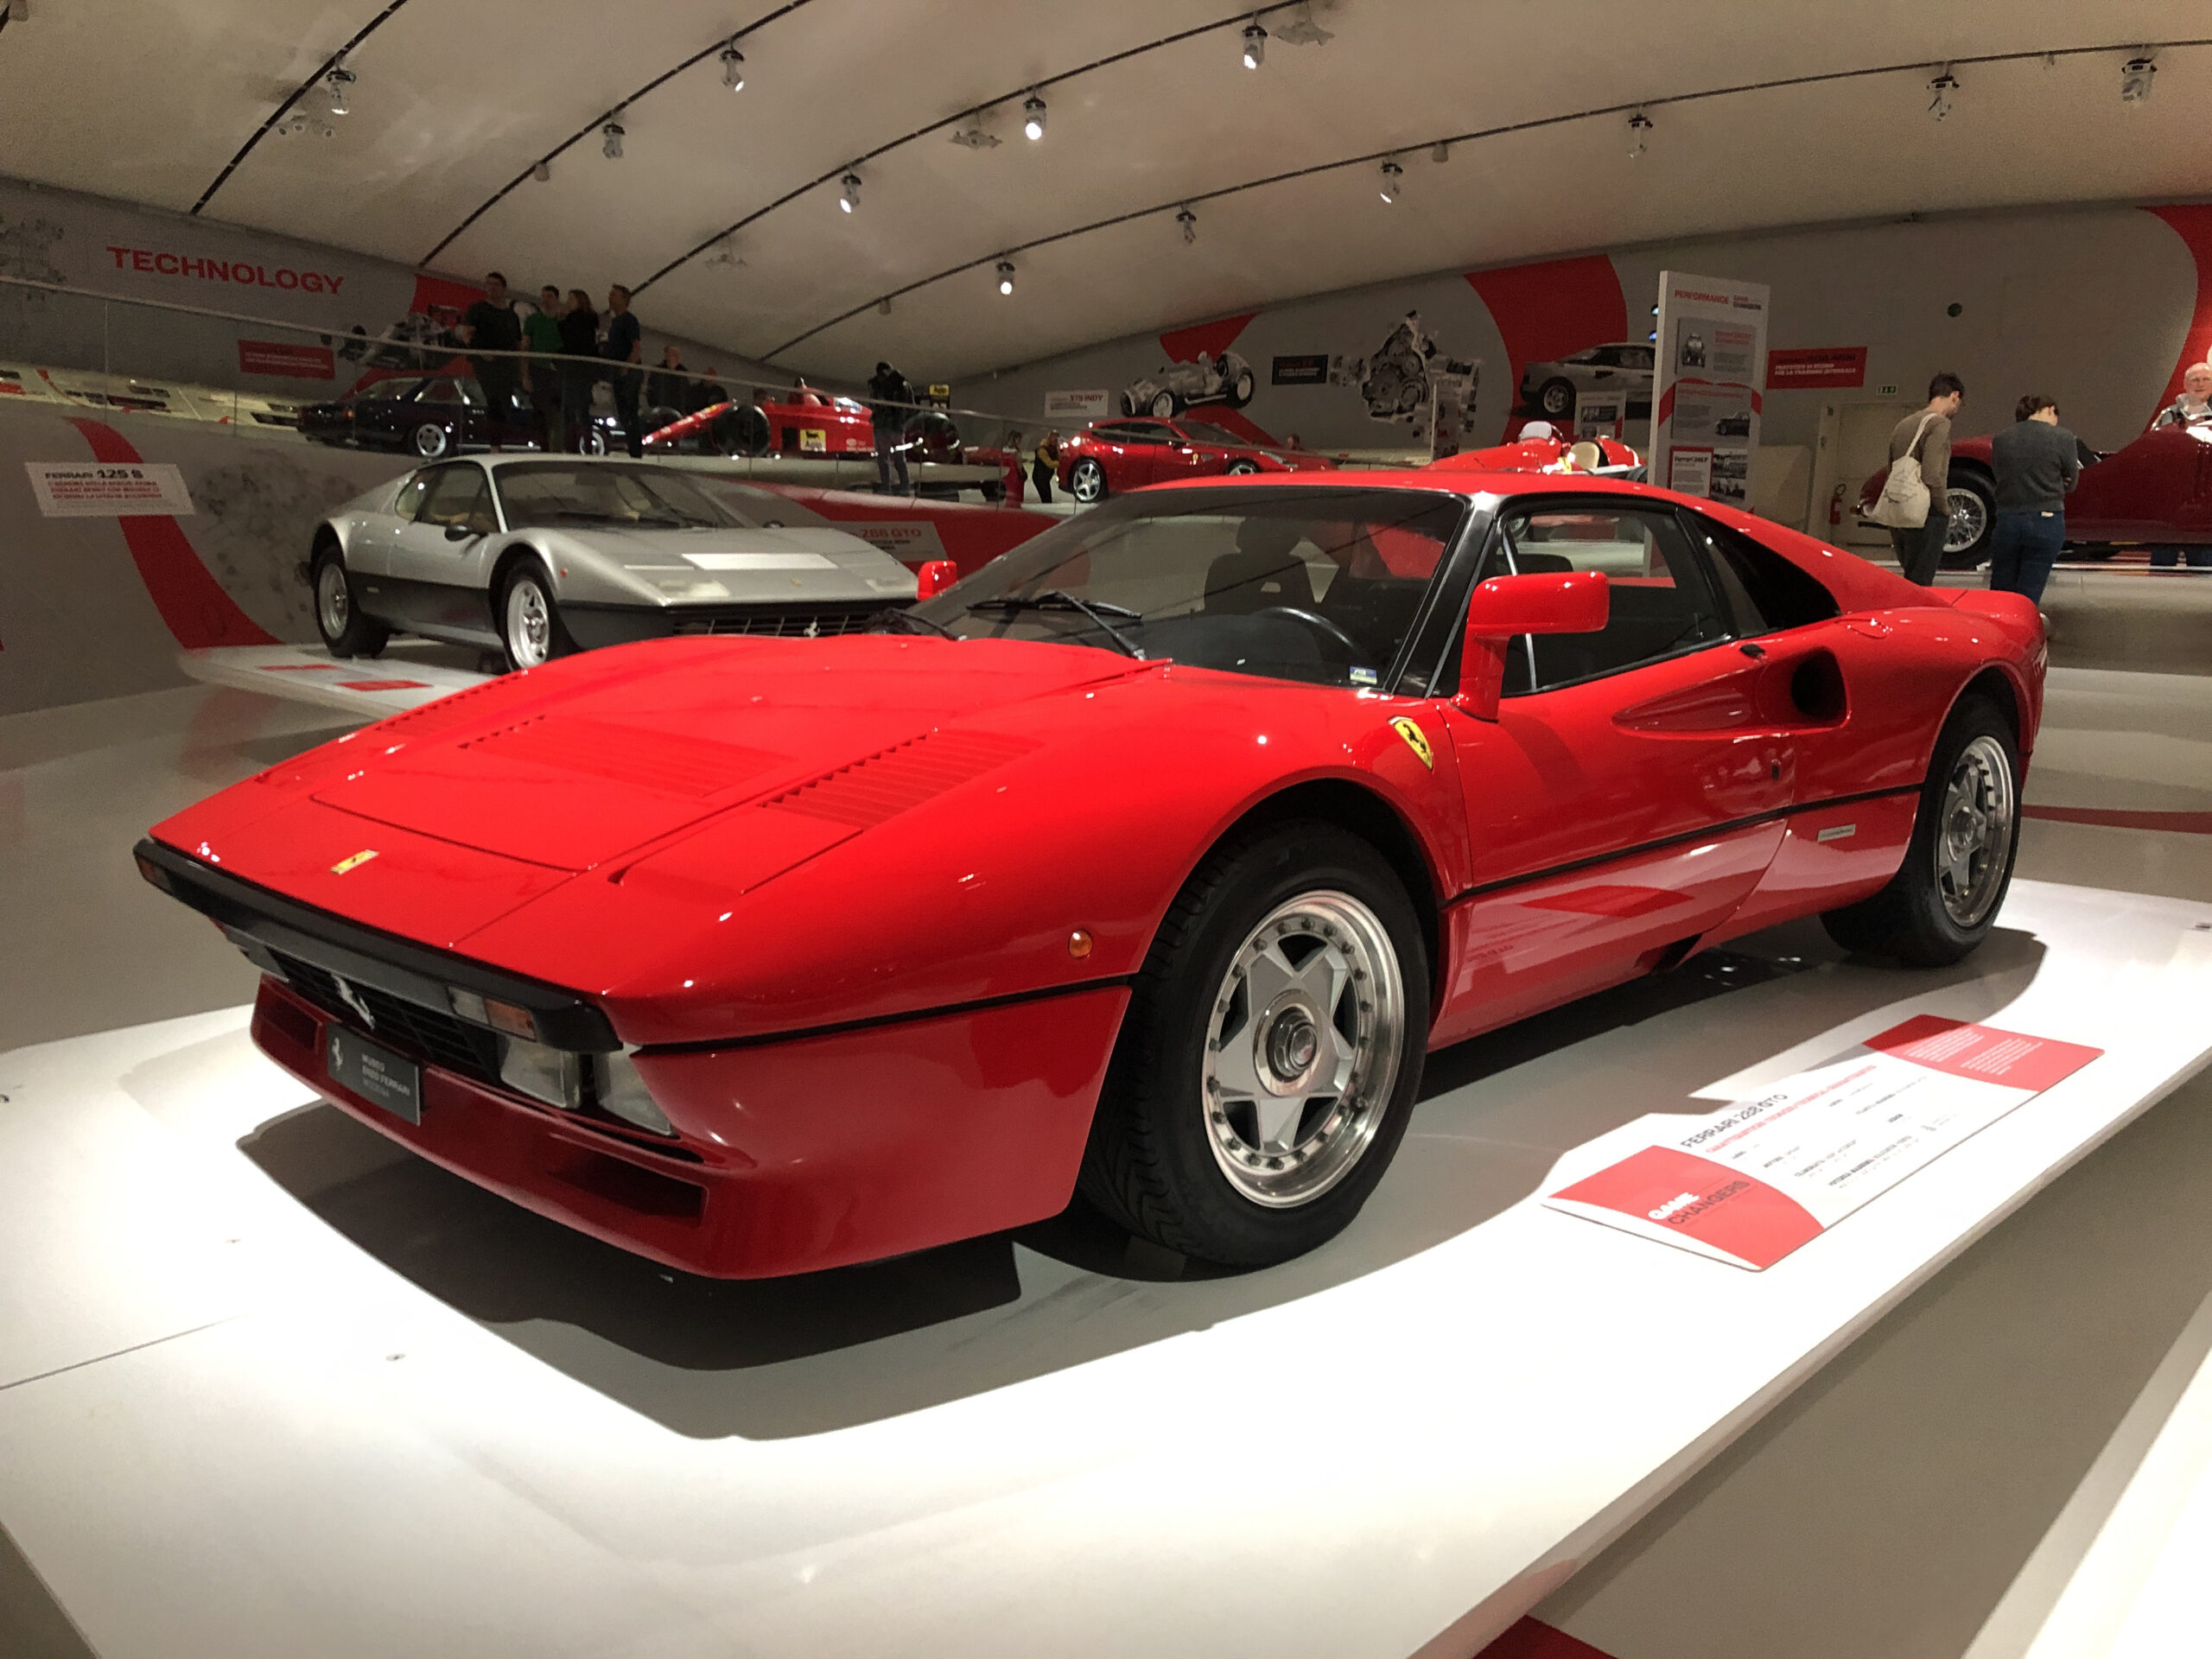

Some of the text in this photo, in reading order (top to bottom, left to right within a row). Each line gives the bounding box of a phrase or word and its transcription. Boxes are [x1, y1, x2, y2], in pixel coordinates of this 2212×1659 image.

[105, 246, 344, 295] TECHNOLOGY
[1675, 289, 1729, 304] PERFORMANCE
[97, 469, 129, 480] 125
[891, 527, 922, 538] GTO
[361, 1053, 385, 1073] MUSEO
[362, 1065, 411, 1097] ENZO FERRARI
[1680, 1116, 1740, 1148] FERRARI
[1734, 1103, 1764, 1122] 288
[1758, 1092, 1789, 1110] GTO
[1647, 1191, 1700, 1220] GAME
[1667, 1179, 1751, 1225] CHANGERS
